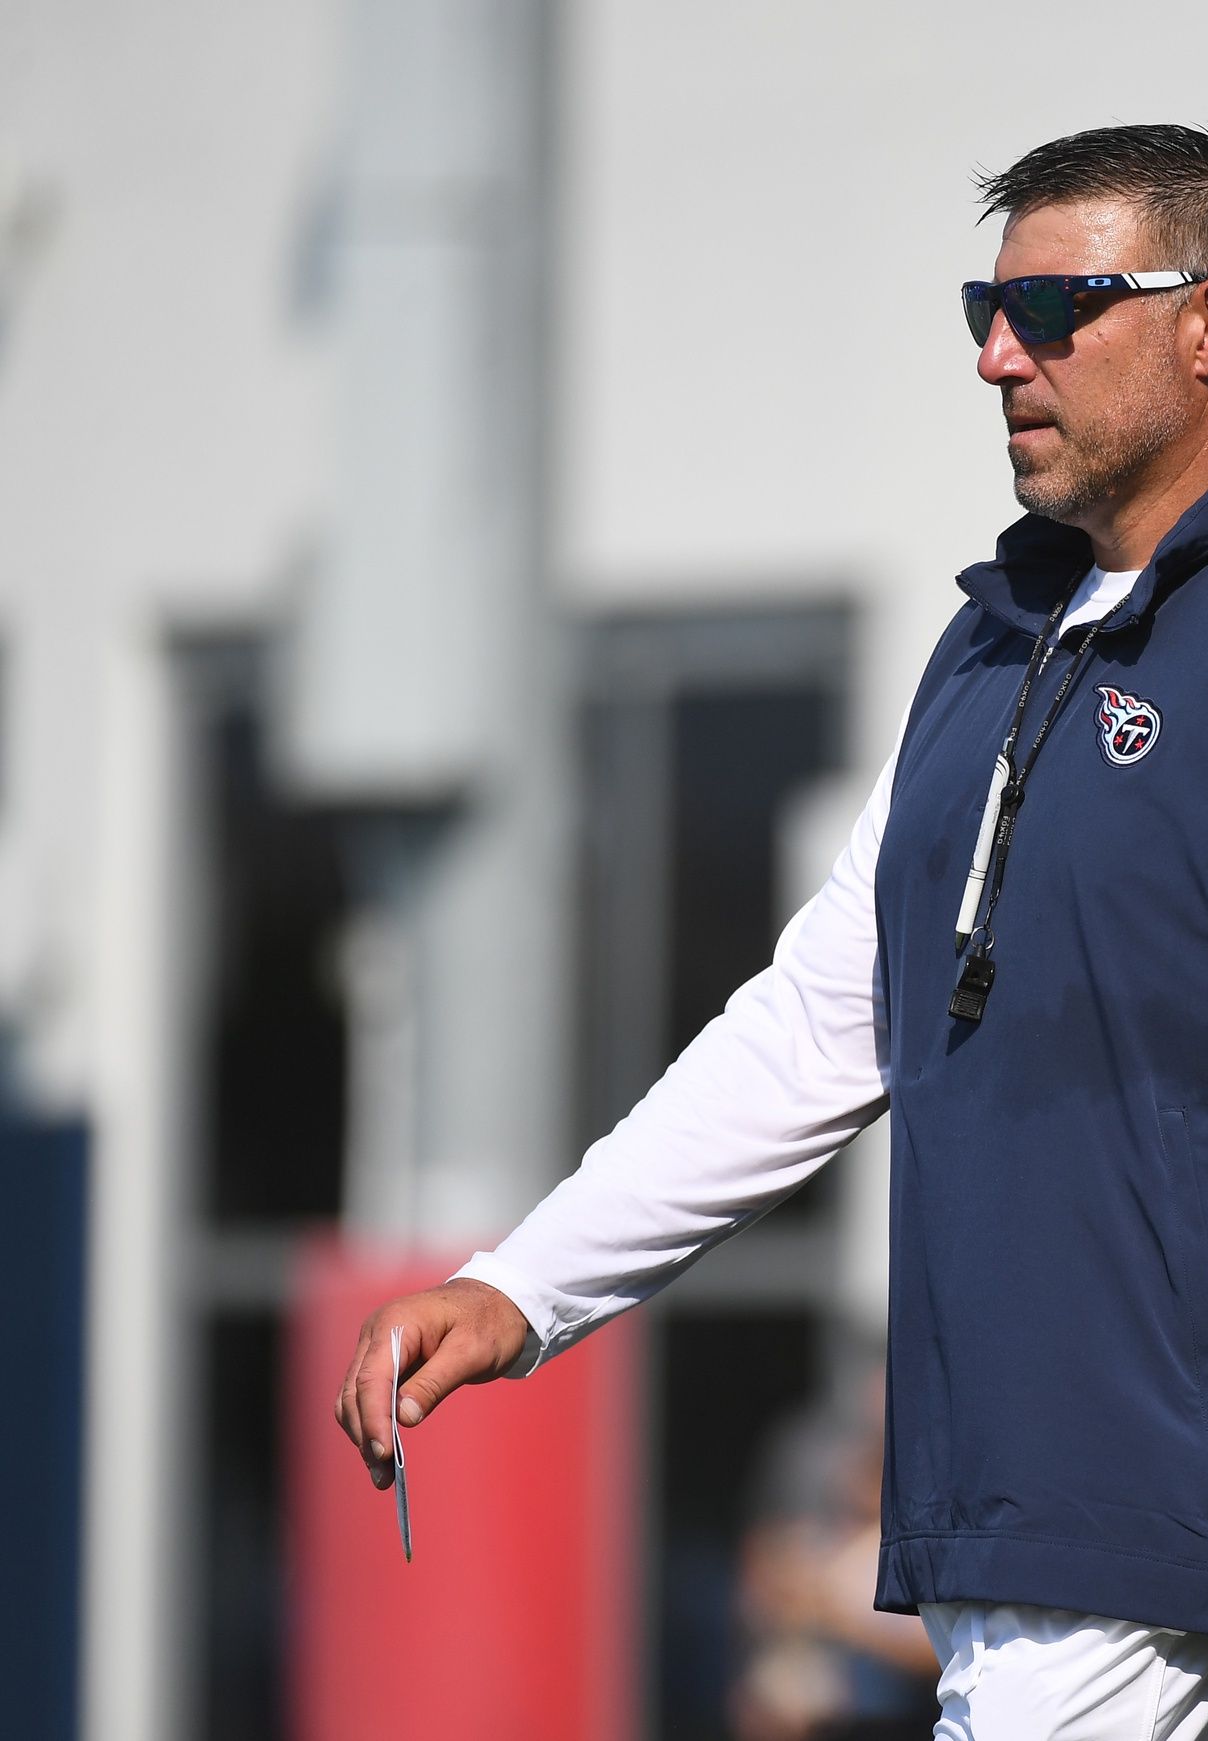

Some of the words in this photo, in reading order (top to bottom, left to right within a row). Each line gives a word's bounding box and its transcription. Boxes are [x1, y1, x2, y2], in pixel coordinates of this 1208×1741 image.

[1078, 626, 1098, 654] FOX40
[1055, 673, 1072, 701] FOX40
[1033, 720, 1049, 749] FOX40
[997, 815, 1009, 846] FOX40
